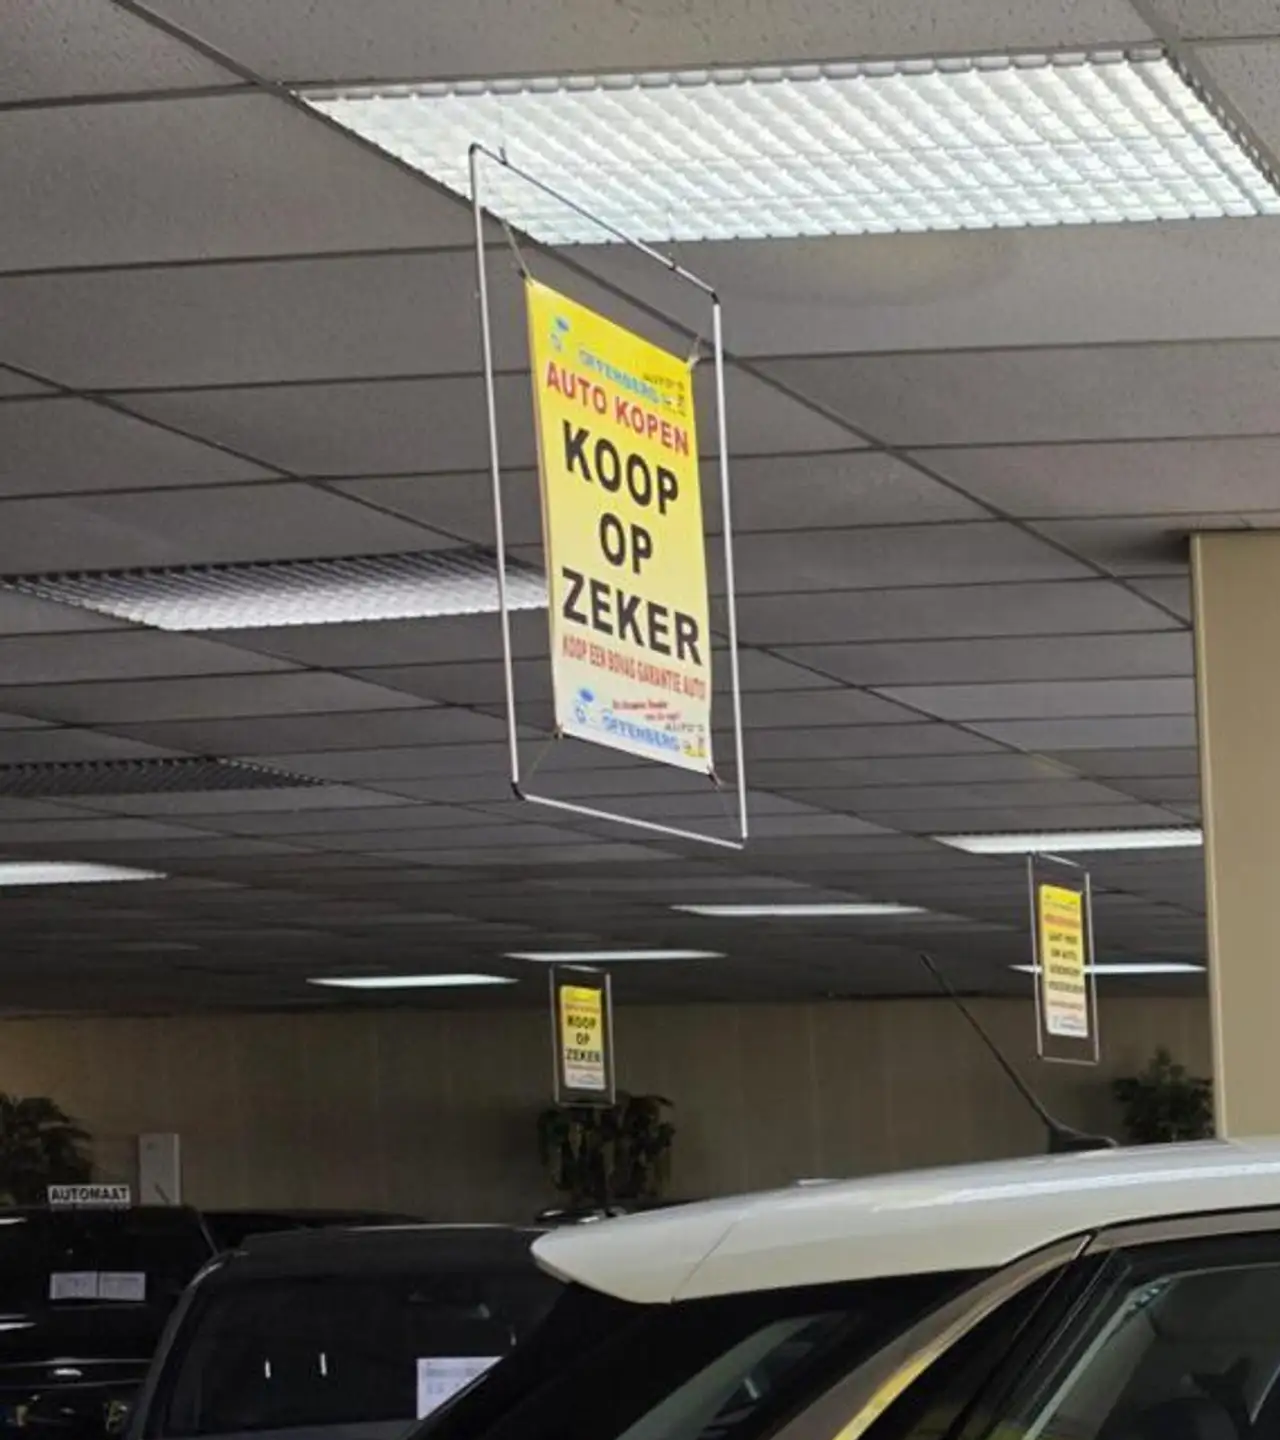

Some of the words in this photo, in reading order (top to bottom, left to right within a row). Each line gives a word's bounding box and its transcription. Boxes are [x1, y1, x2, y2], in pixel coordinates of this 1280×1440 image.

[547, 361, 607, 416] AUTO
[616, 396, 690, 457] KOPEN
[562, 418, 680, 516] KOOP
[600, 512, 653, 575] OP
[561, 565, 703, 667] ZEKER
[51, 1186, 128, 1200] AUTOMAAT
